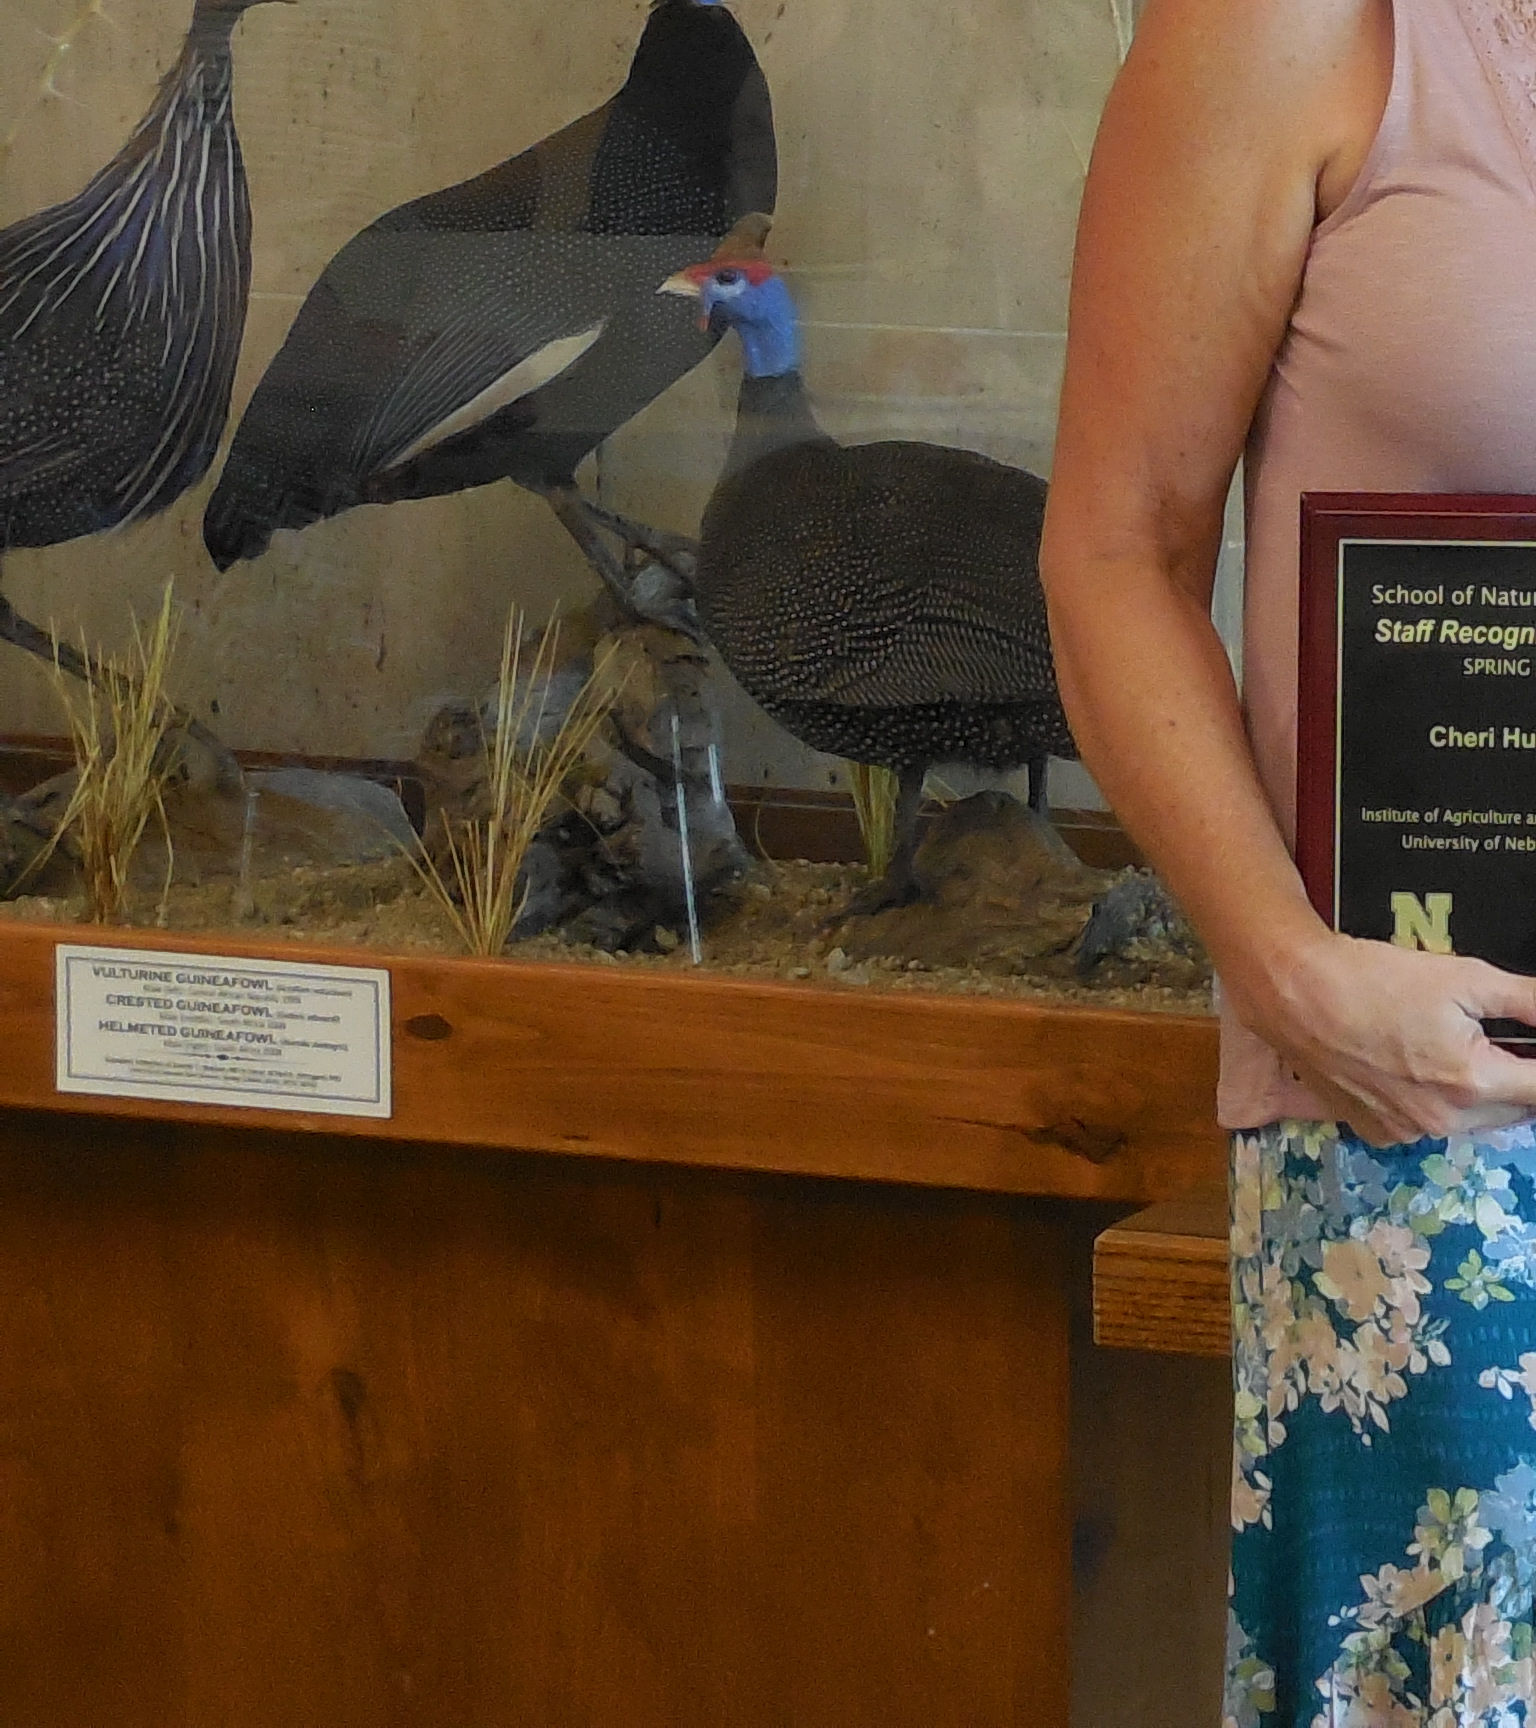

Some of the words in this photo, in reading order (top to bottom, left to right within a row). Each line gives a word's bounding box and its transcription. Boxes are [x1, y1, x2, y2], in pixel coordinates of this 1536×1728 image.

[1372, 585, 1444, 606] School
[1452, 586, 1477, 606] of
[1375, 618, 1433, 642] Staff
[1463, 658, 1530, 676] SPRING
[1430, 726, 1495, 748] Cheri
[1361, 808, 1420, 824] Institute
[1424, 809, 1440, 824] of
[1444, 809, 1521, 828] Agriculture
[1402, 834, 1479, 854] University
[1484, 836, 1500, 852] of
[1389, 892, 1454, 954] N
[93, 966, 172, 982] VULTURINE
[176, 973, 273, 991] GUINEAFOWL
[106, 994, 173, 1008] CRESTED
[176, 1000, 272, 1017] GUINEAFOWL
[99, 1020, 177, 1036] HELMETED
[180, 1027, 277, 1044] GUINEAFOWL
